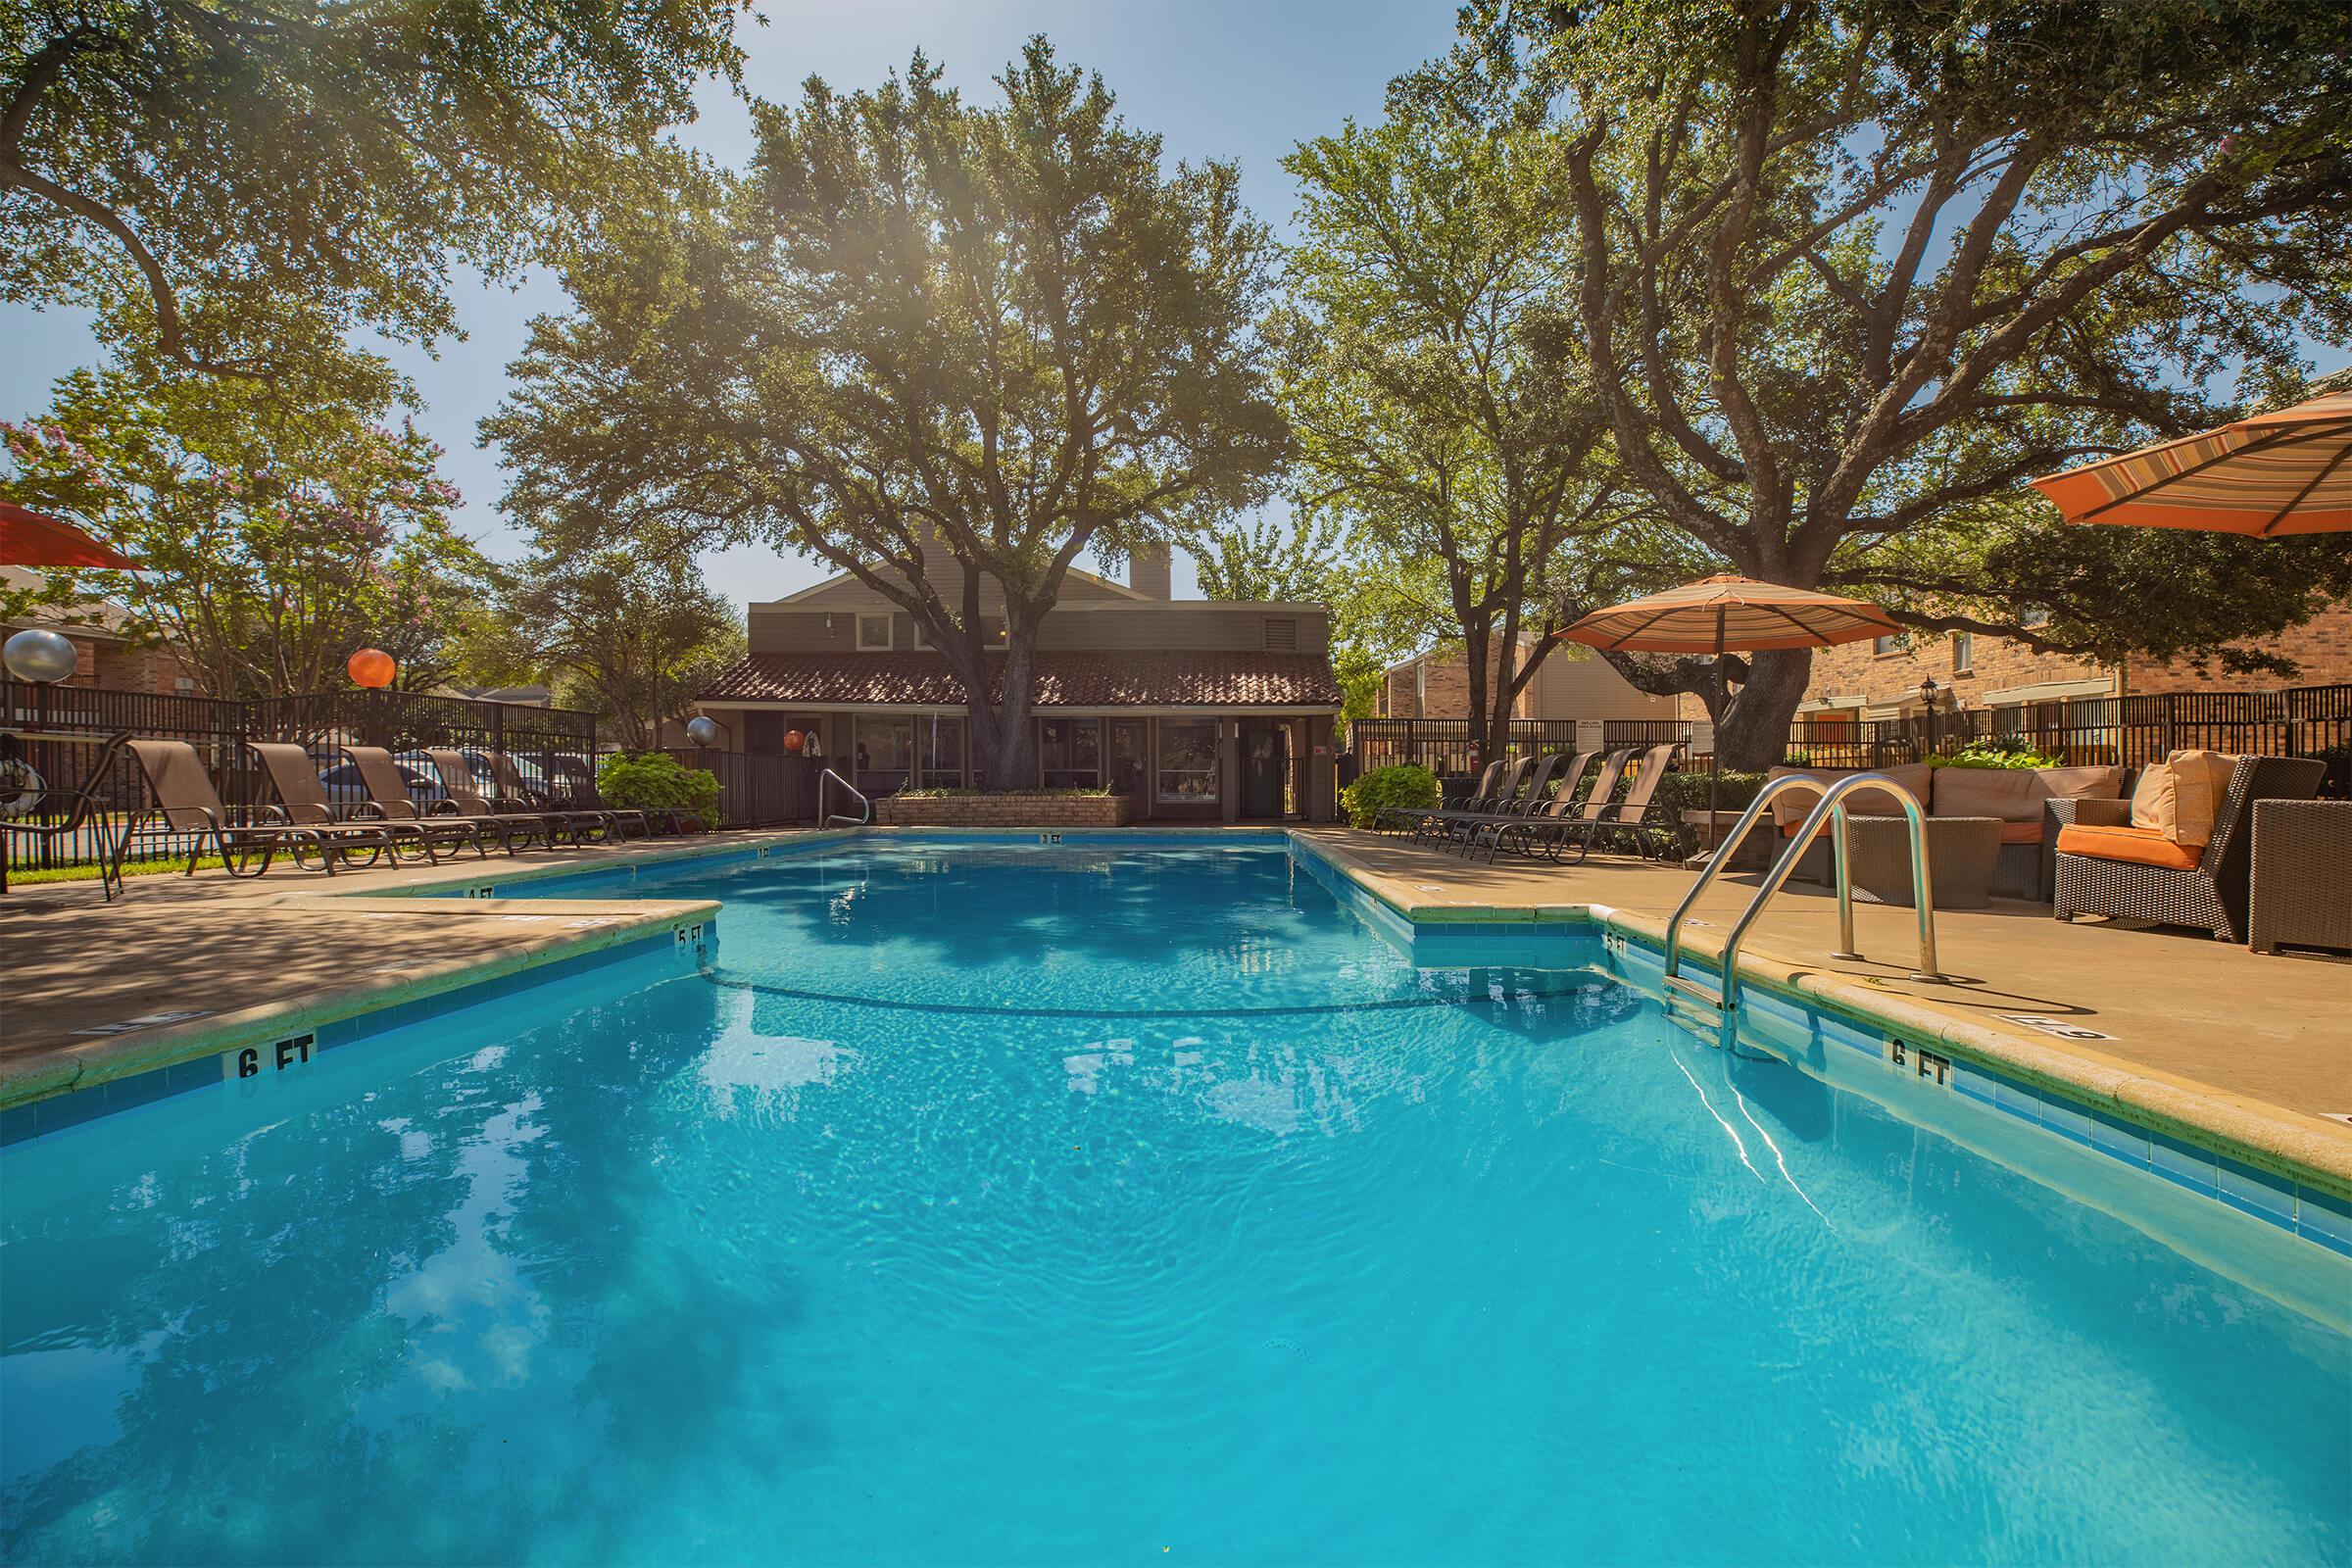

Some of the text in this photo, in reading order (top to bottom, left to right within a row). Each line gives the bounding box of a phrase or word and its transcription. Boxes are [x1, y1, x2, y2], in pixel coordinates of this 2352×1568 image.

[238, 1033, 314, 1078] 6 FT
[1892, 1039, 1949, 1086] 6 FT
